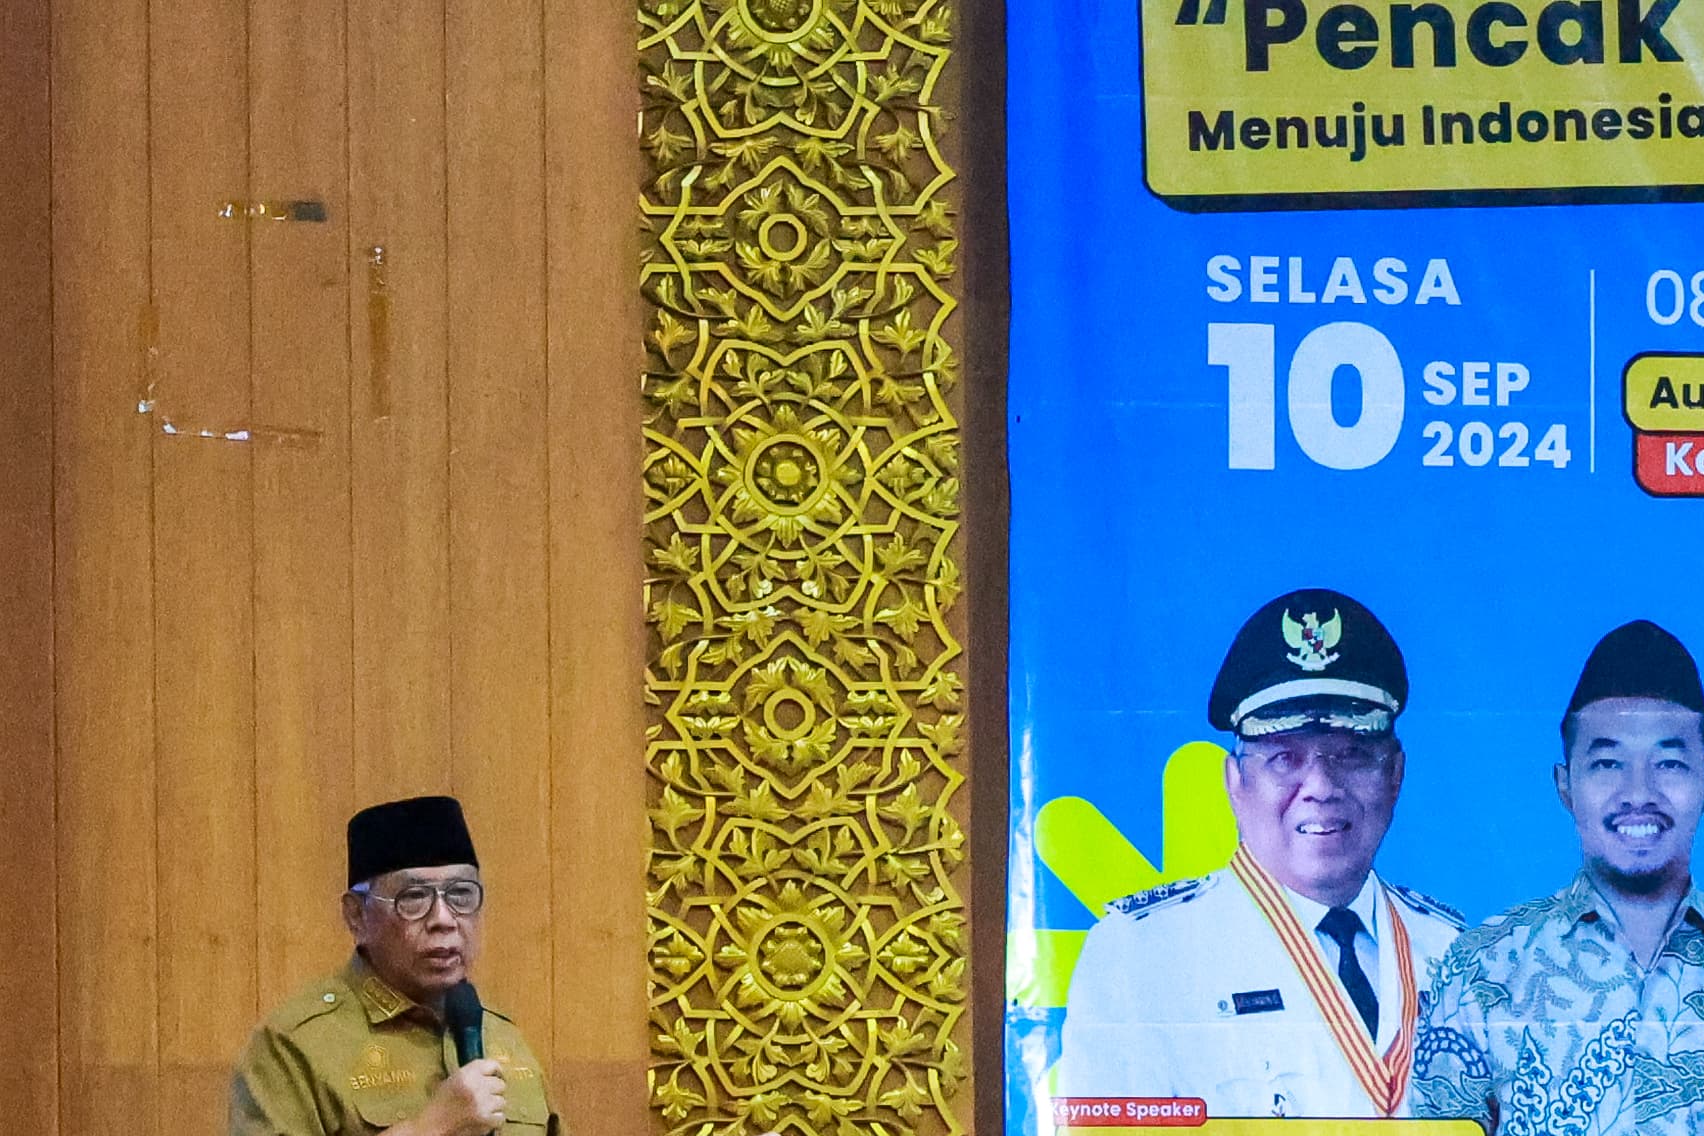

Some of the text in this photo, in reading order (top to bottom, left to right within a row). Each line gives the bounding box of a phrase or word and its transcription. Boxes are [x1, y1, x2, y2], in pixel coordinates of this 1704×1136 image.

[1188, 102, 1405, 161] Menuju
[1206, 255, 1461, 306] SELASA
[1206, 321, 1406, 471] 10
[1422, 361, 1530, 407] SEP
[1421, 420, 1571, 469] 2024
[1126, 1102, 1201, 1119] Speaker
